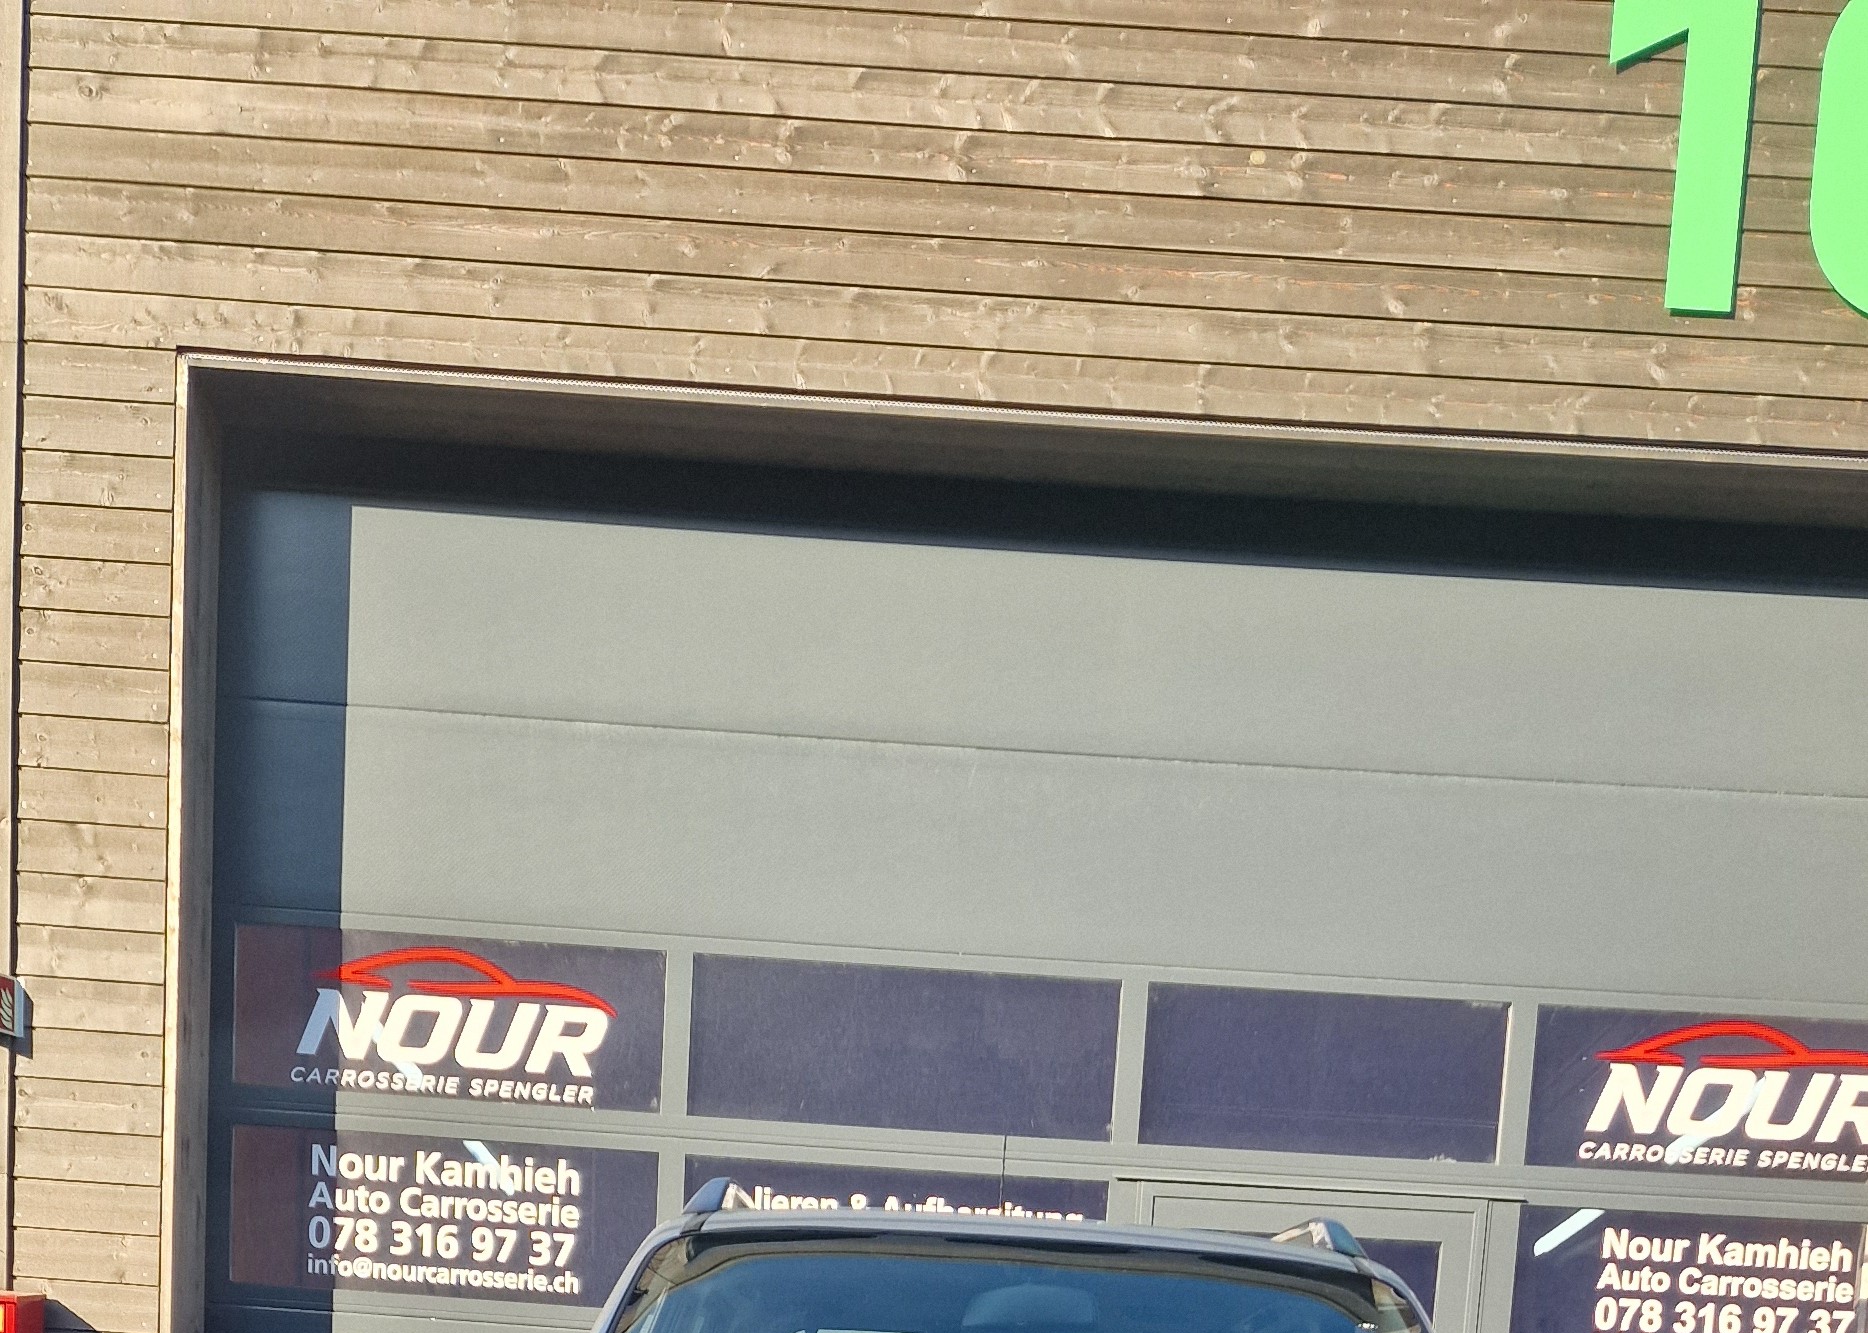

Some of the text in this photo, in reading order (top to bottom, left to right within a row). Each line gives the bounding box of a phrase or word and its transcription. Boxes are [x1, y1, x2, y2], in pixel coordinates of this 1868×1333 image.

[296, 988, 608, 1078] NOUR
[290, 1066, 594, 1105] CARROSSERIE SPENGLER
[311, 1143, 580, 1196] Nour Kamhieh
[1578, 1141, 1868, 1174] CARROSSERIE SPENGLE
[309, 1182, 580, 1229] Auto Carrosserie
[309, 1215, 575, 1267] 078 316 97 37
[1601, 1227, 1853, 1272] Nour Kamhieh
[307, 1254, 580, 1294] info@nourcarrosserie.ch
[1597, 1263, 1855, 1303] Auto Carrosserie
[1594, 1297, 1662, 1333] 078
